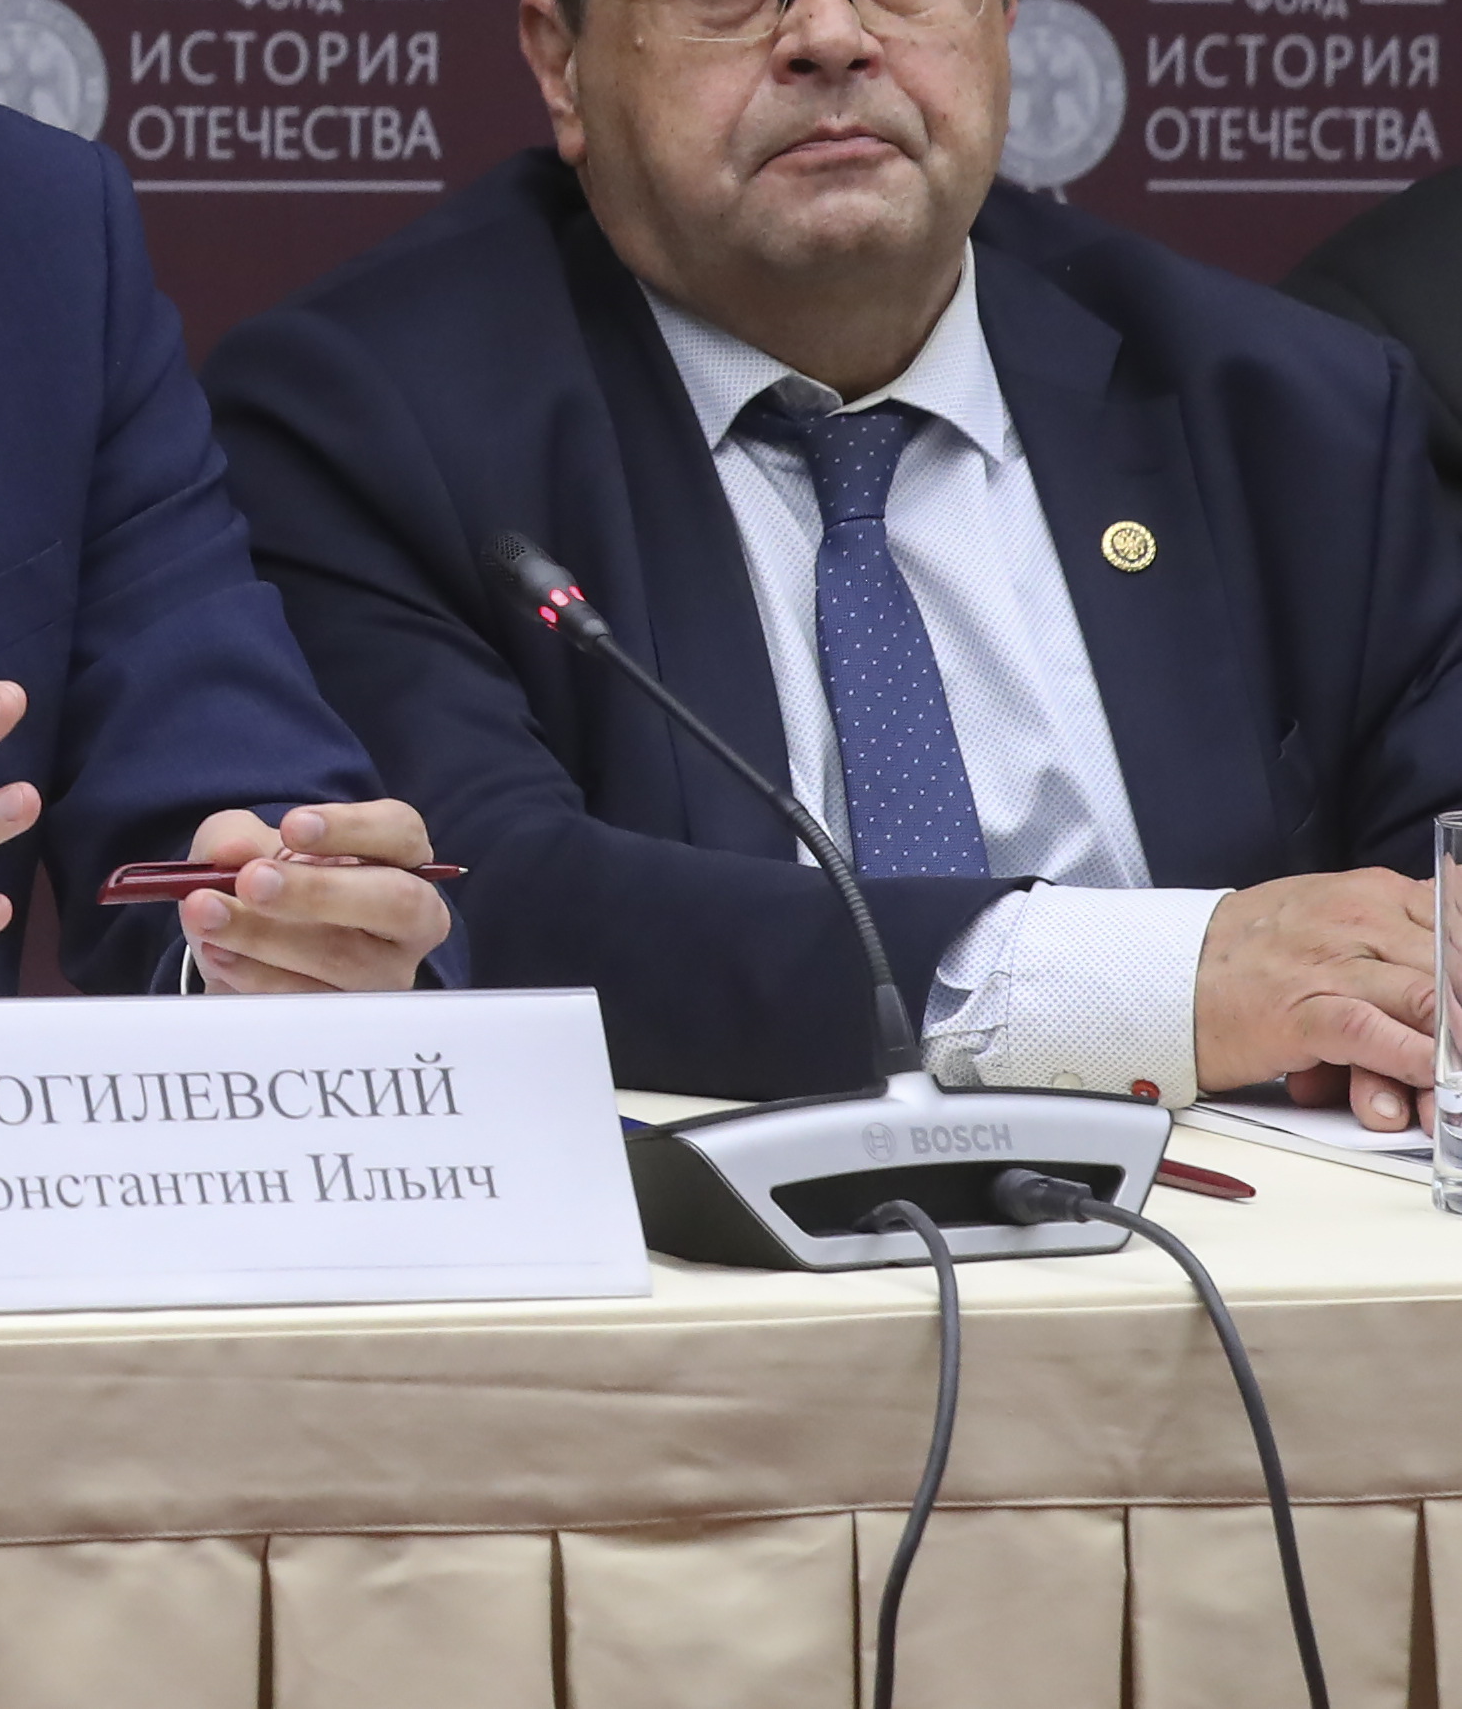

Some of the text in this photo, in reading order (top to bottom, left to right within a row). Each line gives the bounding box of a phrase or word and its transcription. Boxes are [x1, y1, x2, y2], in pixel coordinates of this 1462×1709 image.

[131, 30, 438, 85] ИСТОРИЯ
[1148, 34, 1438, 88] ИСТОРИЯ
[129, 105, 441, 160] ОТЕЧЕСТВА
[1145, 107, 1440, 161] ОТЕЧЕСТВА
[910, 1124, 1013, 1154] BOSCH
[308, 1152, 501, 1205] Ильич
